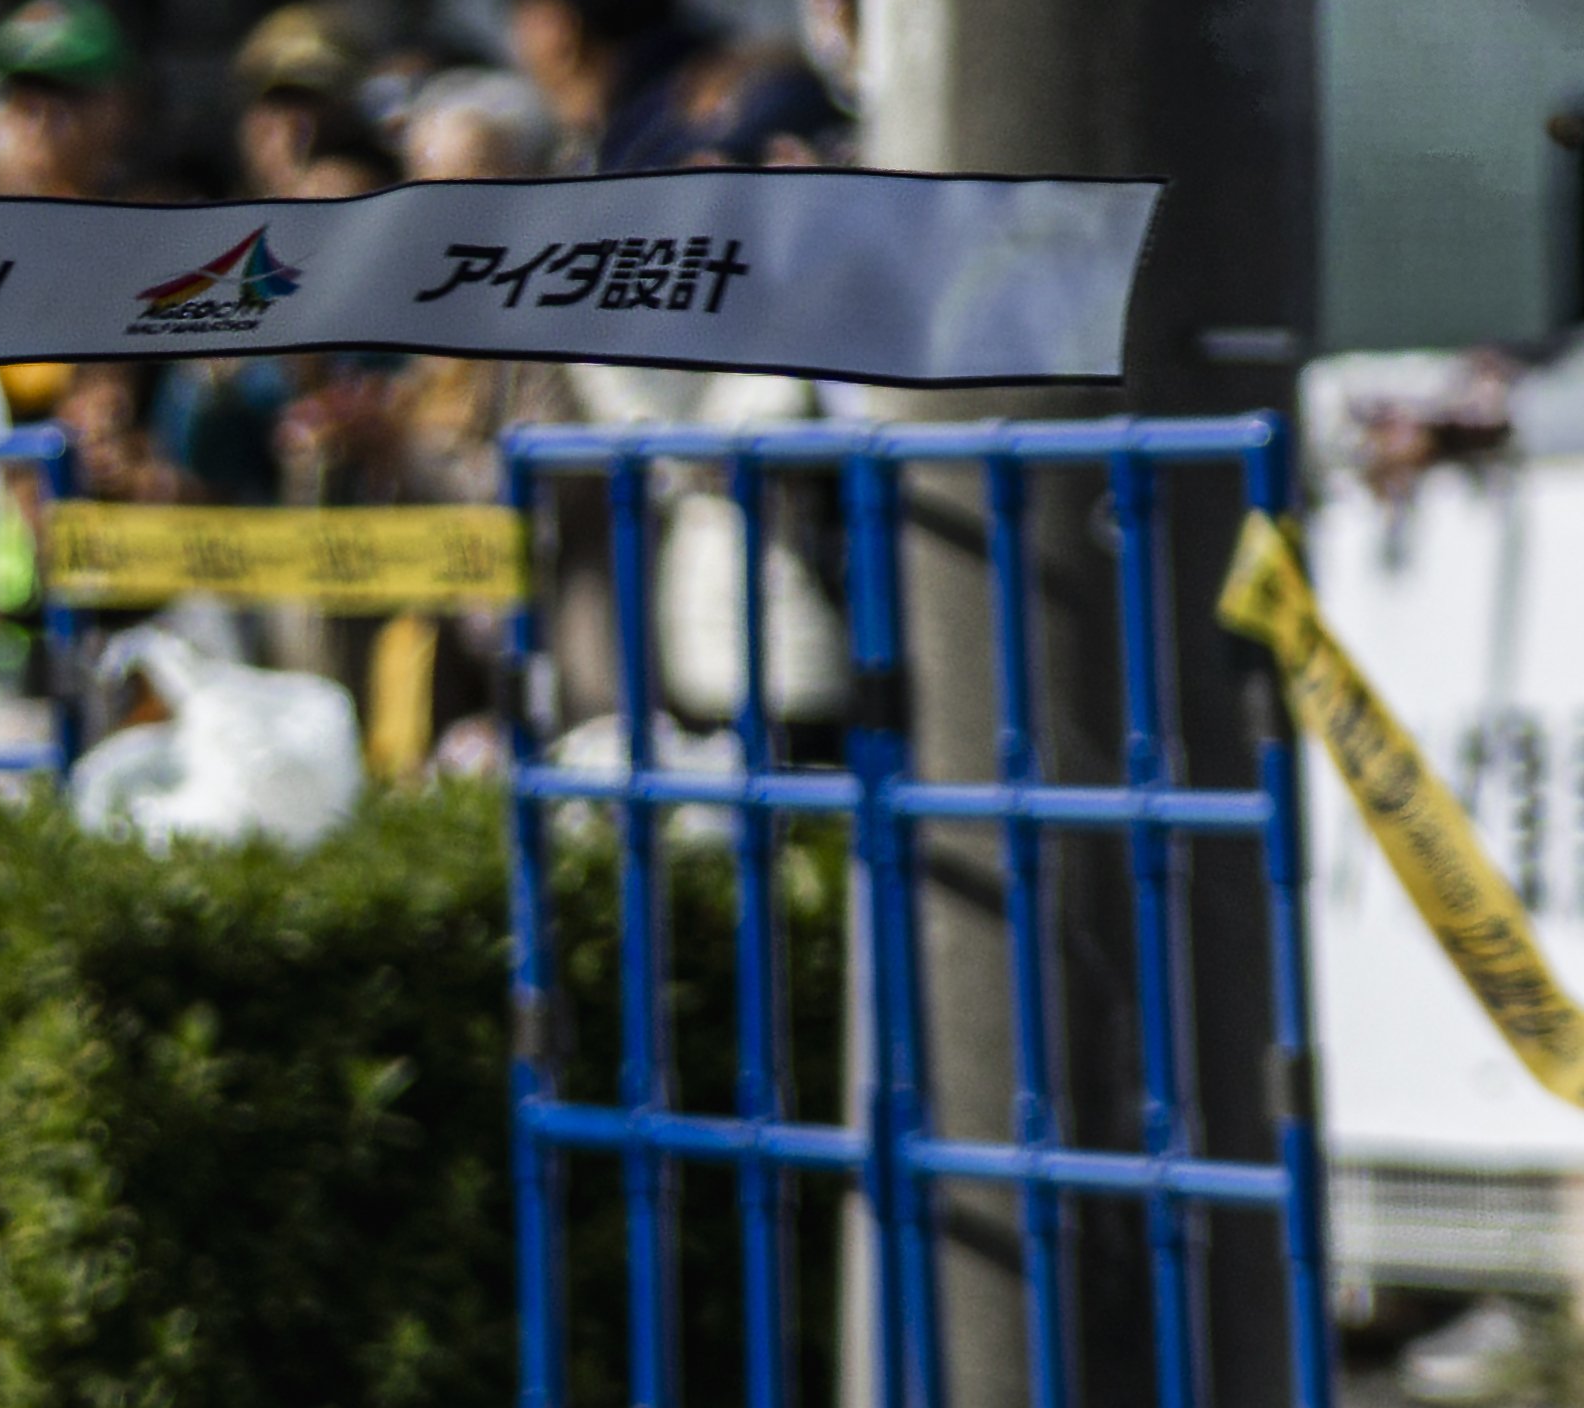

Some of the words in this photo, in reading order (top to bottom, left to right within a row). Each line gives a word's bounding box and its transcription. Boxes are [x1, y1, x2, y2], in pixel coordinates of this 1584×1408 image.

[413, 236, 749, 314] アイダ設計
